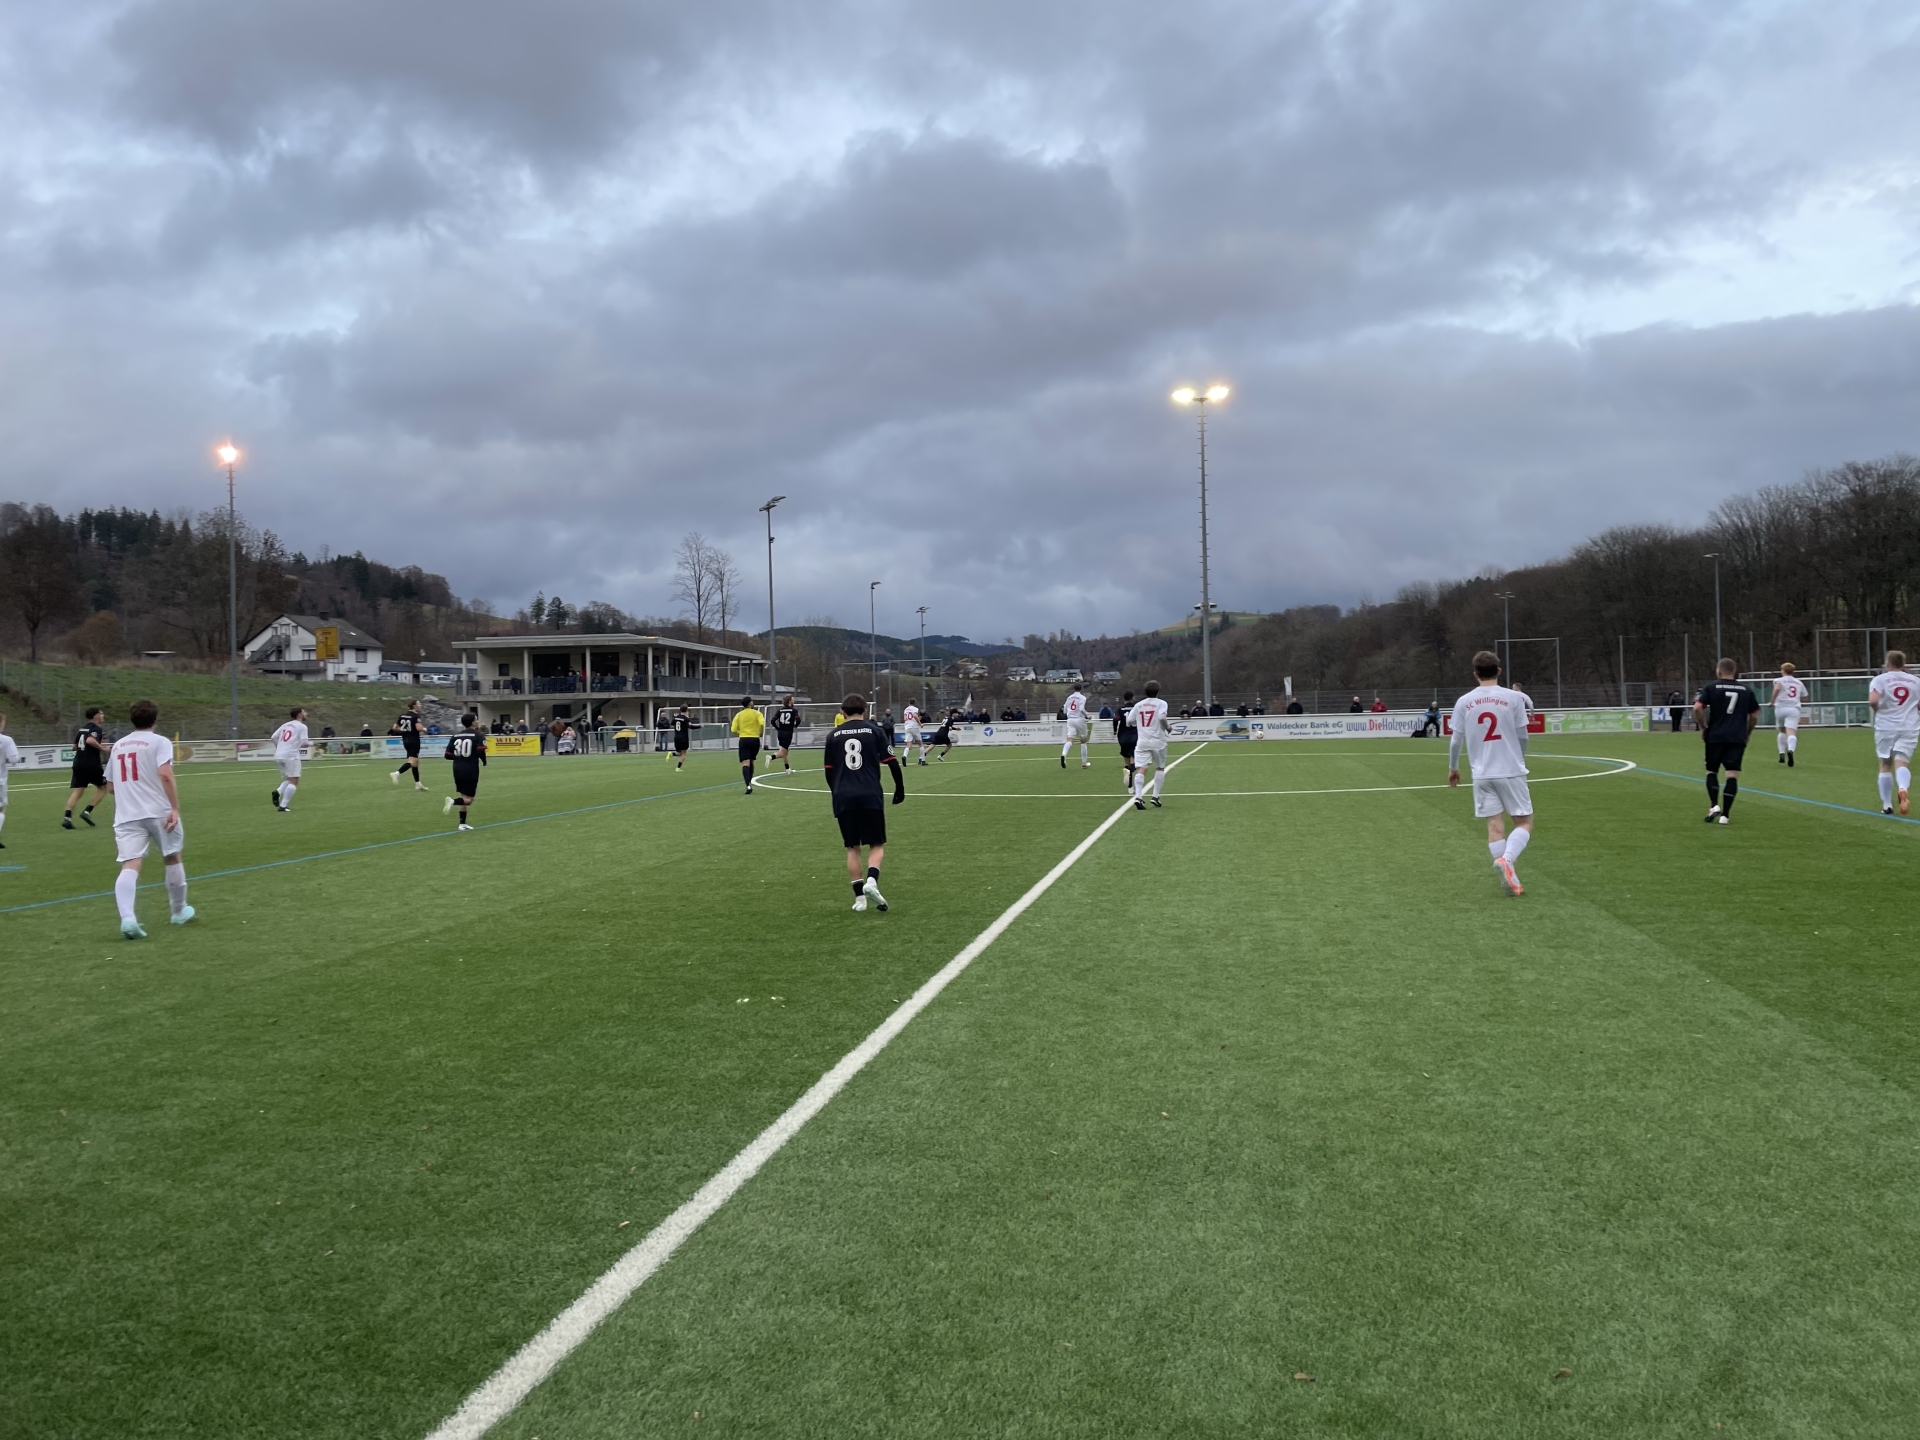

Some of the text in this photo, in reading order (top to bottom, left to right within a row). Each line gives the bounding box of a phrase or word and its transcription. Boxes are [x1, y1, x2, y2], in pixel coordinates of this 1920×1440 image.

[1787, 686, 1797, 698] 3
[1893, 686, 1909, 706] 9
[1070, 699, 1077, 711] 6
[1466, 701, 1474, 710] SC
[1475, 697, 1509, 707] Willingen
[1725, 691, 1739, 714] 7
[400, 720, 411, 731] 23
[675, 721, 681, 732] 6
[779, 712, 791, 725] 42
[1139, 710, 1155, 727] 17
[1267, 722, 1308, 730] Waldecker
[1346, 717, 1425, 733] www.DieHolzgestalt
[1477, 711, 1502, 742] 2
[78, 734, 86, 751] 4
[281, 730, 292, 742] 10
[453, 739, 472, 757] 30
[844, 738, 862, 770] 8
[117, 752, 138, 782] 11
